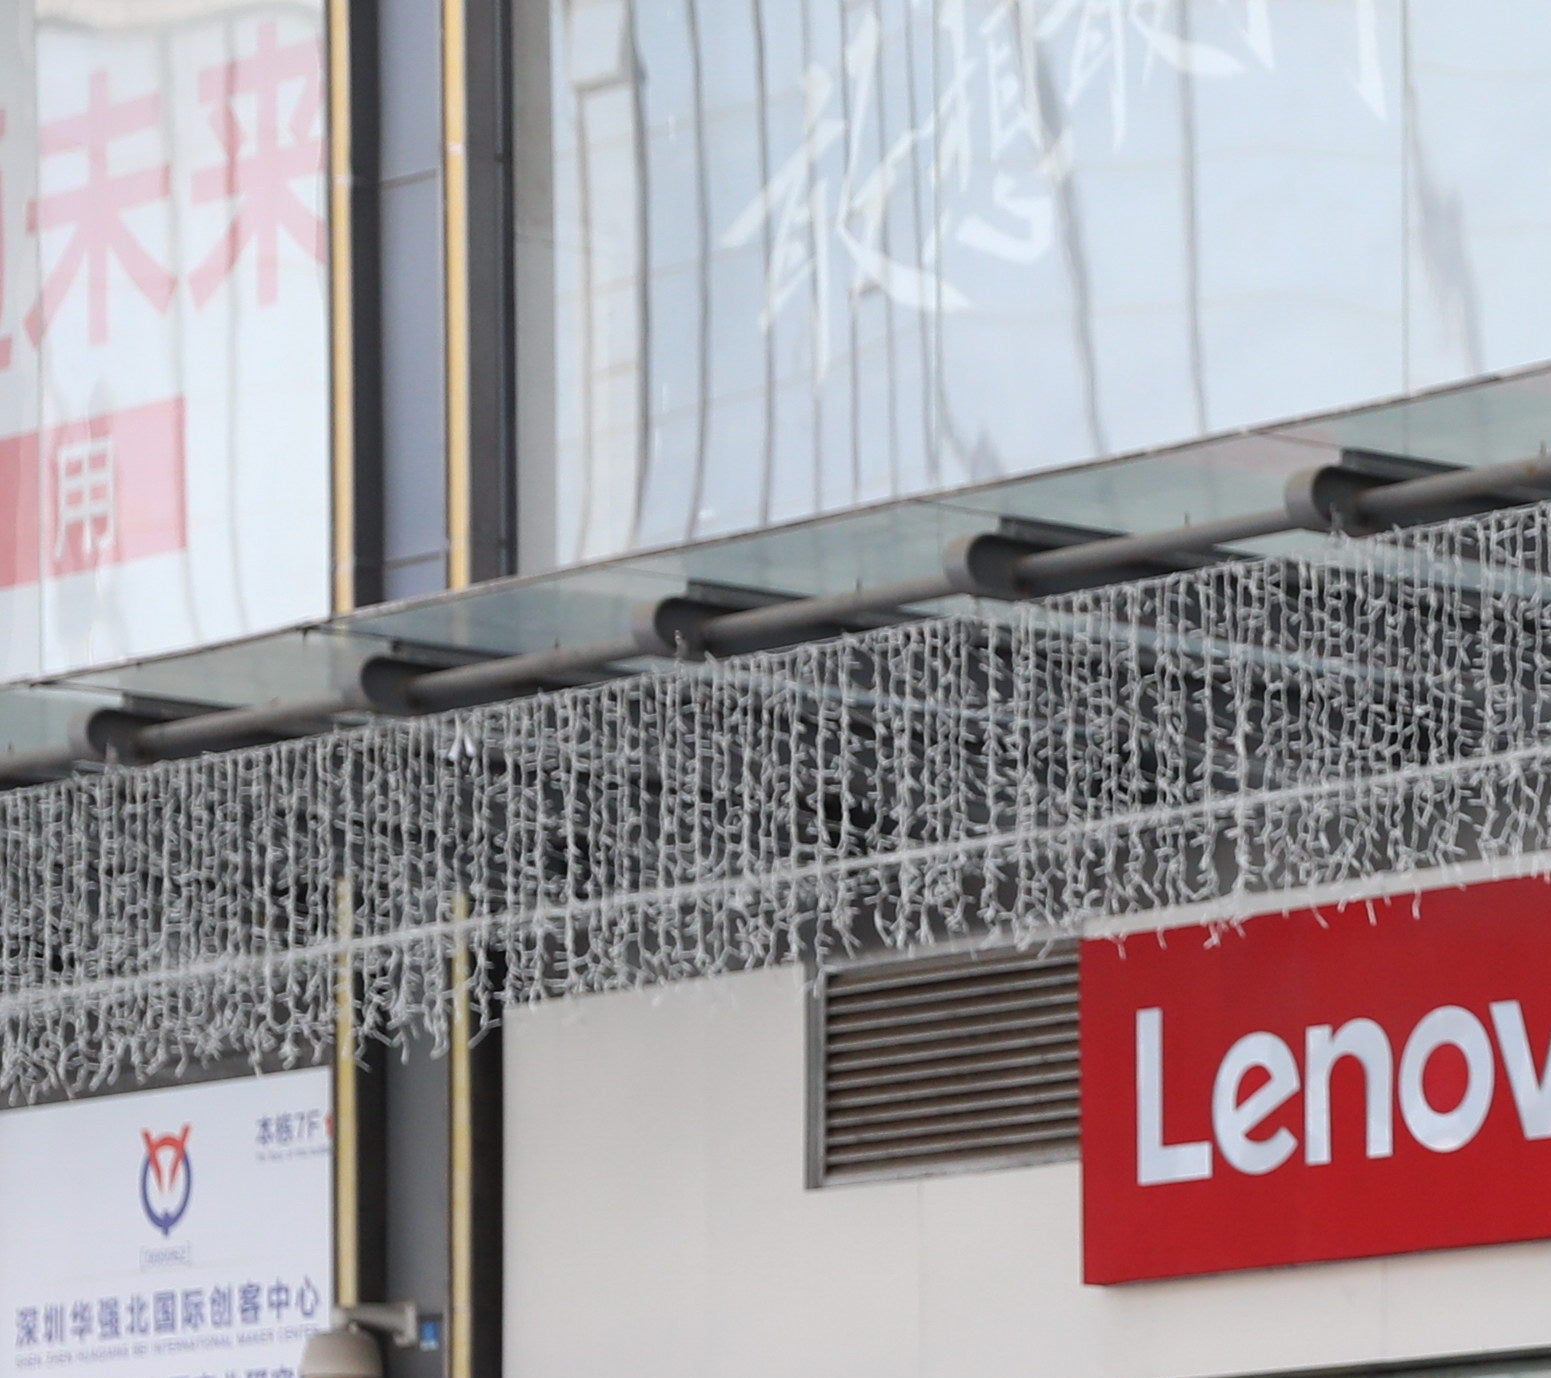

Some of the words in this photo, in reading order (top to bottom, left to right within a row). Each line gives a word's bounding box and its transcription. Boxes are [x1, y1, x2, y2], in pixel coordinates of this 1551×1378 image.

[0, 26, 328, 348] 未来
[49, 437, 118, 564] 用
[15, 1277, 321, 1350] 深圳华强北国际创客中心
